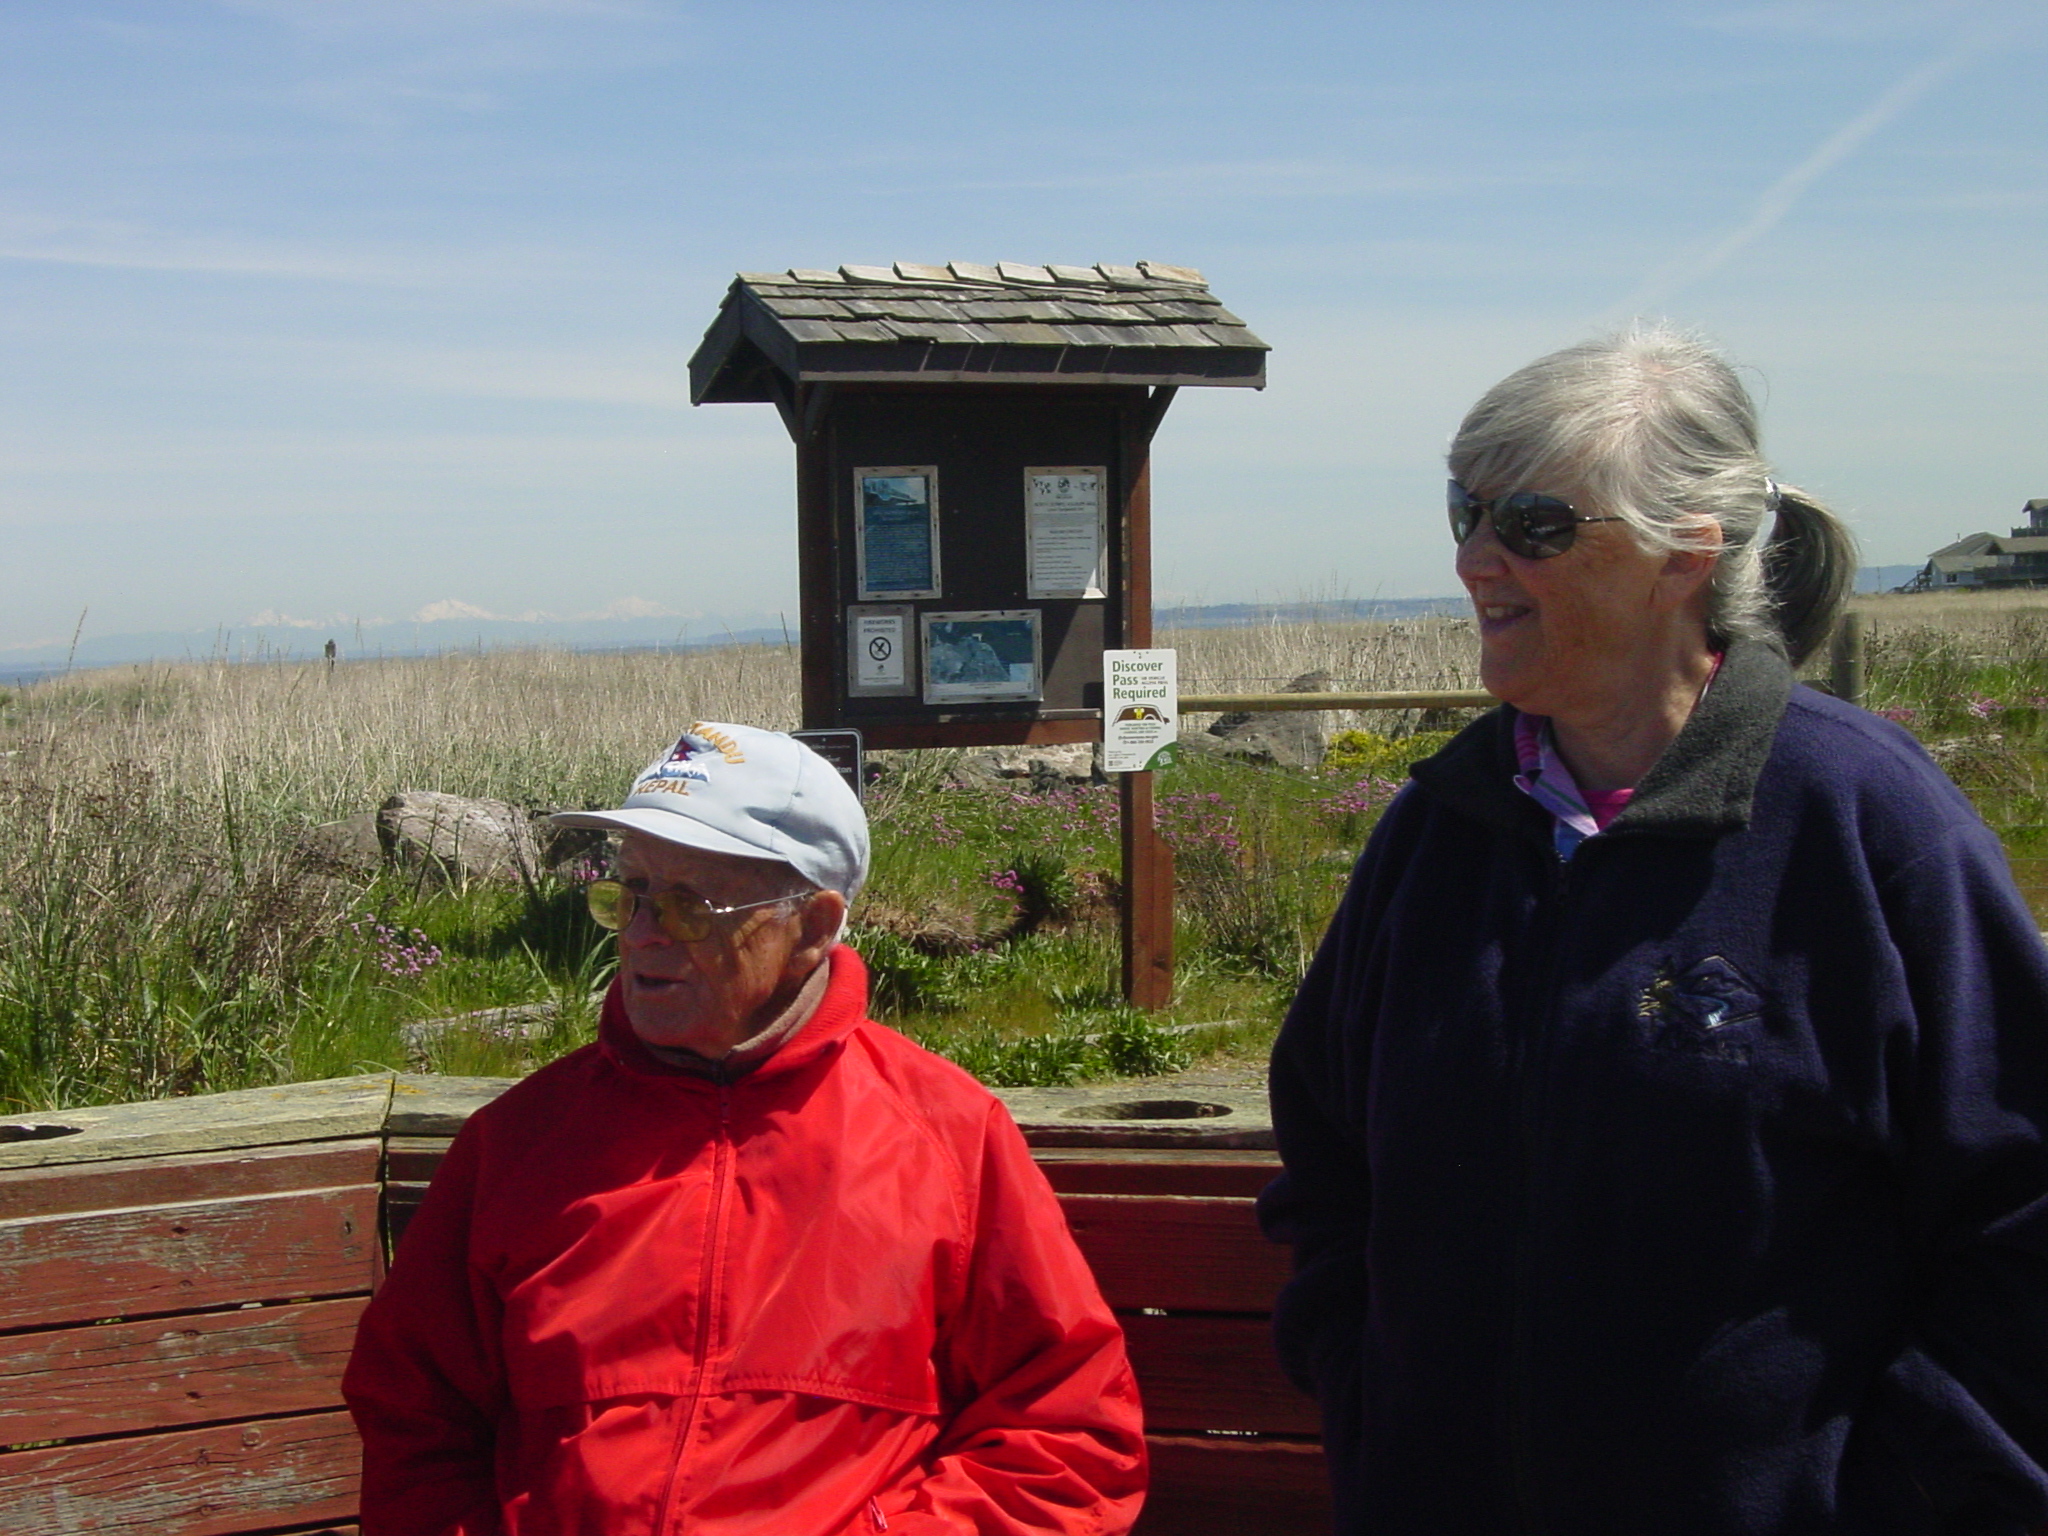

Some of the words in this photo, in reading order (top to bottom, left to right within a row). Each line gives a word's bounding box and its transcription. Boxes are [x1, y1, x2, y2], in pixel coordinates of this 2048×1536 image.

[1112, 660, 1163, 672] Discover
[1113, 674, 1138, 686] Pass
[1113, 686, 1166, 702] Required
[632, 779, 689, 797] NEPAL
